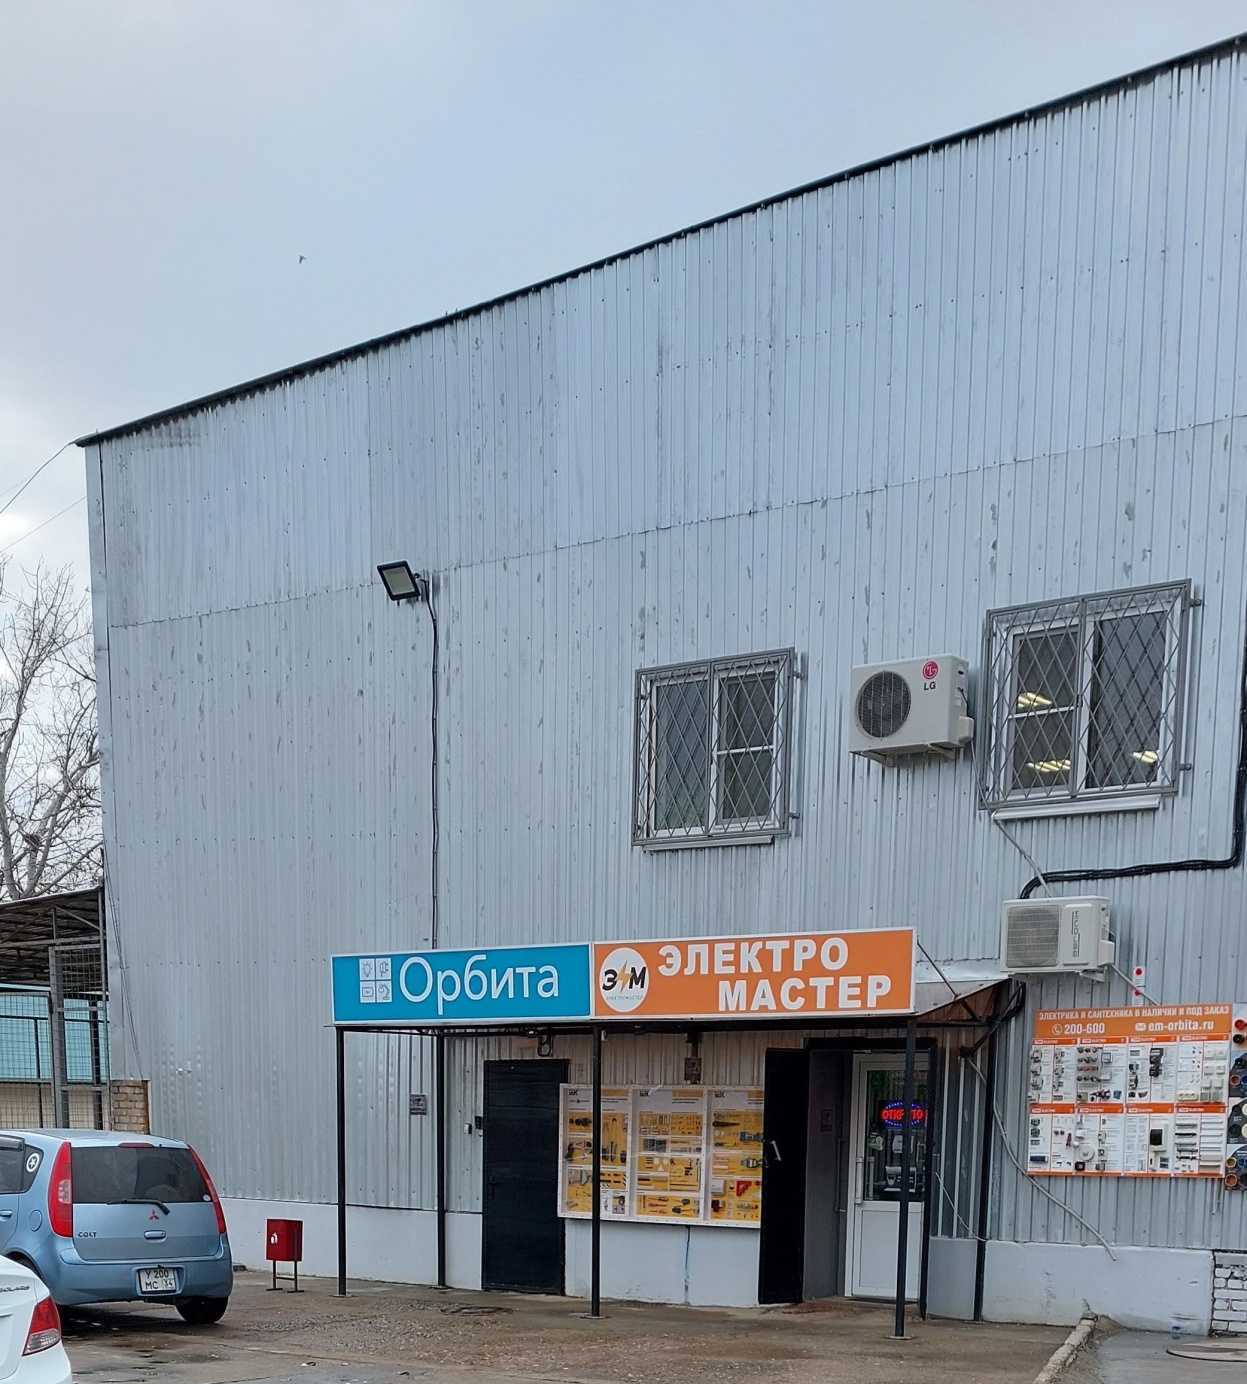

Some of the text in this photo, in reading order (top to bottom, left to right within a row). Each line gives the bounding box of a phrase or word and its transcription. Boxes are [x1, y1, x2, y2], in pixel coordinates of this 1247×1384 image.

[924, 681, 936, 690] LG
[658, 937, 848, 976] ЭЛЕКТРО
[400, 954, 559, 1015] Орбита
[718, 975, 892, 1012] МАСТЕР
[1040, 1010, 1079, 1021] ЭЛЕКТРИКА
[1087, 1009, 1133, 1019] САНТЕХНИКА
[1142, 1007, 1177, 1017] НАЛИЧИИ
[1186, 1006, 1202, 1016] ПОД
[1204, 1005, 1229, 1015] ЗАКАЗ
[1064, 1023, 1105, 1034] 200-600
